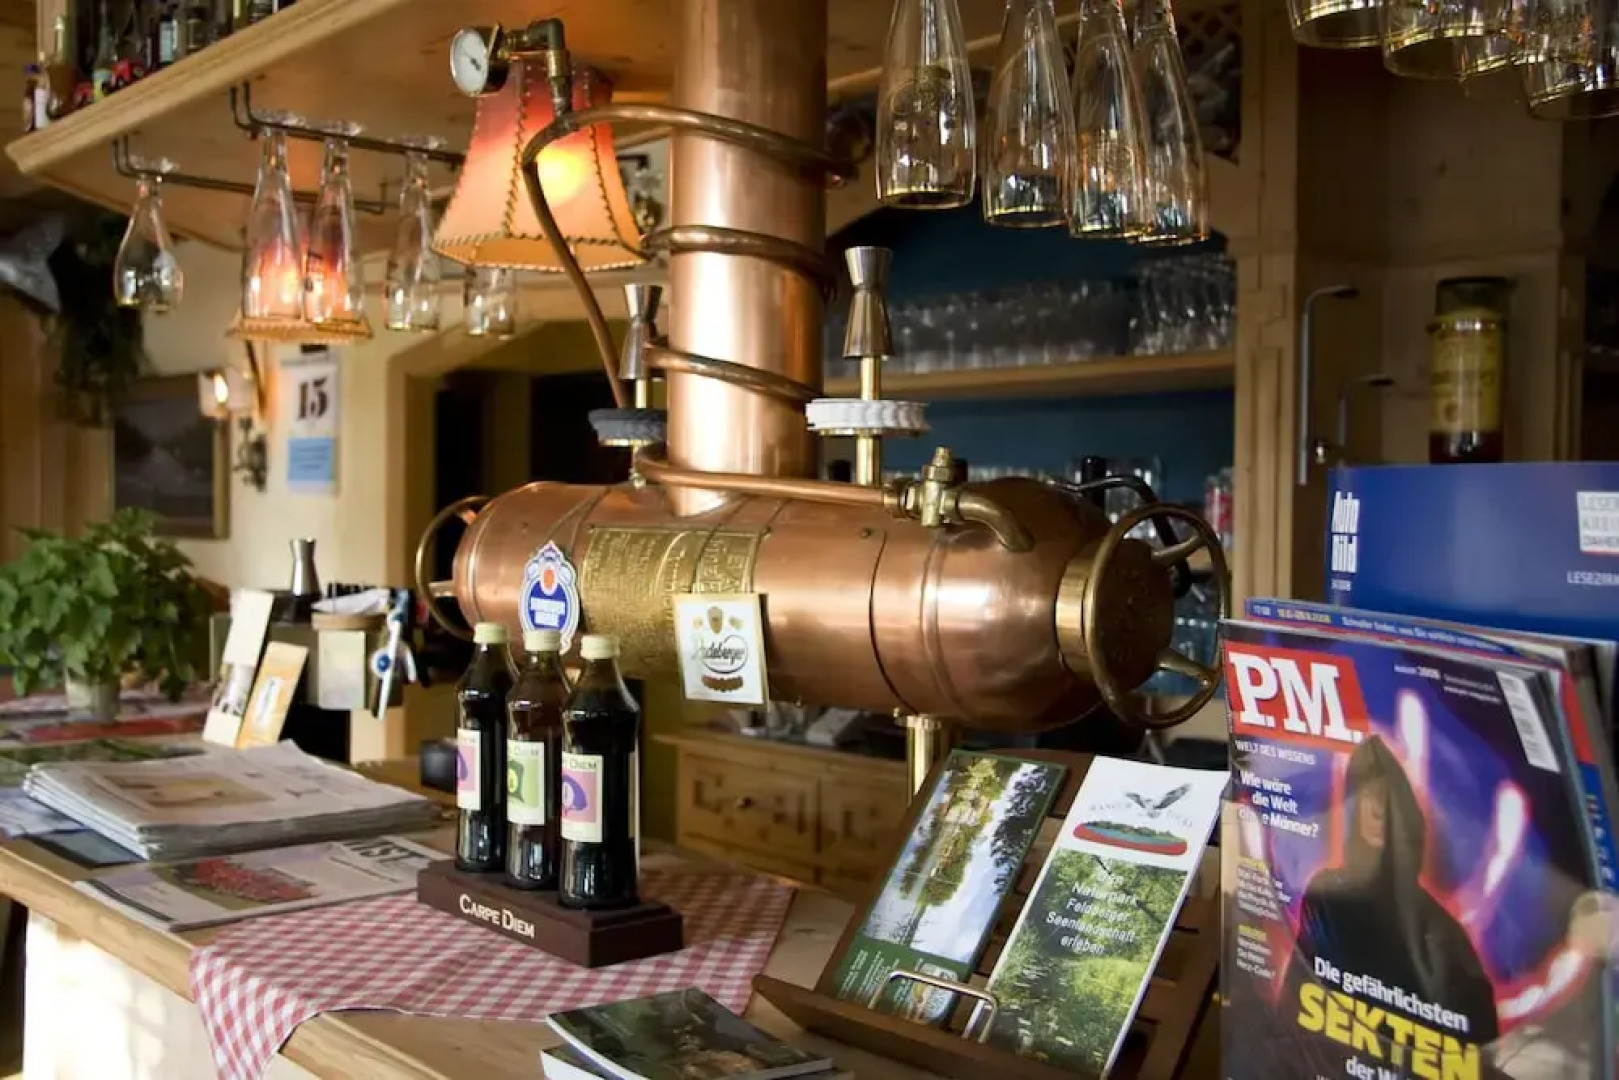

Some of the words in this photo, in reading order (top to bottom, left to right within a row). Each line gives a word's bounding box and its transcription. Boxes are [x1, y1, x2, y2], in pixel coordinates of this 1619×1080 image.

[297, 377, 328, 421] 15
[1228, 650, 1364, 744] P.M.
[1241, 770, 1261, 788] Wie
[1262, 778, 1292, 795] wäre
[1252, 790, 1270, 807] die
[1270, 794, 1299, 815] Welt
[1270, 812, 1319, 838] Männer?
[1071, 881, 1139, 908] Naturpark
[1046, 911, 1136, 944] Seenlandschaft
[1060, 934, 1105, 955] erleben
[1313, 956, 1342, 984] Die
[1342, 970, 1470, 1034] gefährlichsten
[1297, 982, 1481, 1080] SEKTEN
